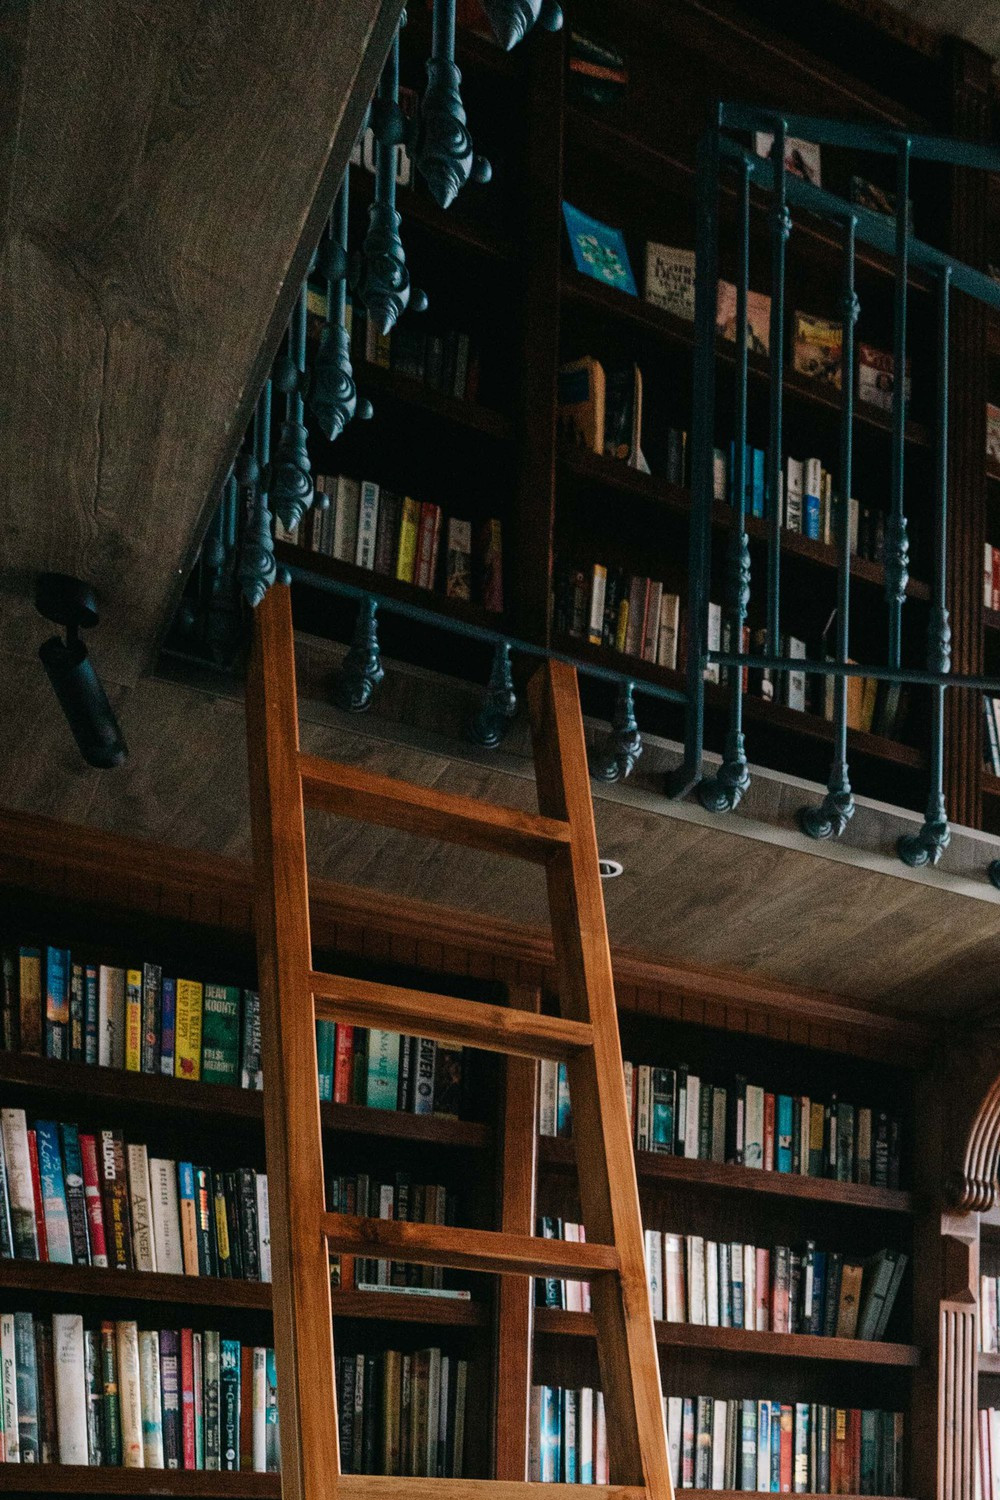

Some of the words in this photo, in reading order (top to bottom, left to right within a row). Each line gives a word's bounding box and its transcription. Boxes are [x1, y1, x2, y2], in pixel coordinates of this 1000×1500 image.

[205, 985, 227, 1000] DEAN
[205, 998, 237, 1016] KOONTZ
[178, 1009, 189, 1040] HAPPY
[189, 1015, 199, 1050] WALKER
[420, 1039, 433, 1079] EAVER
[41, 1142, 53, 1172] Love
[102, 1130, 116, 1180] BALDACCI
[160, 1168, 168, 1206] BACKLASH
[134, 1221, 149, 1261] ANGEL
[4, 1359, 13, 1384] Rooted
[163, 1355, 177, 1375] TELL
[164, 1377, 177, 1391] NO
[5, 1397, 13, 1428] America
[165, 1392, 178, 1411] ONE
